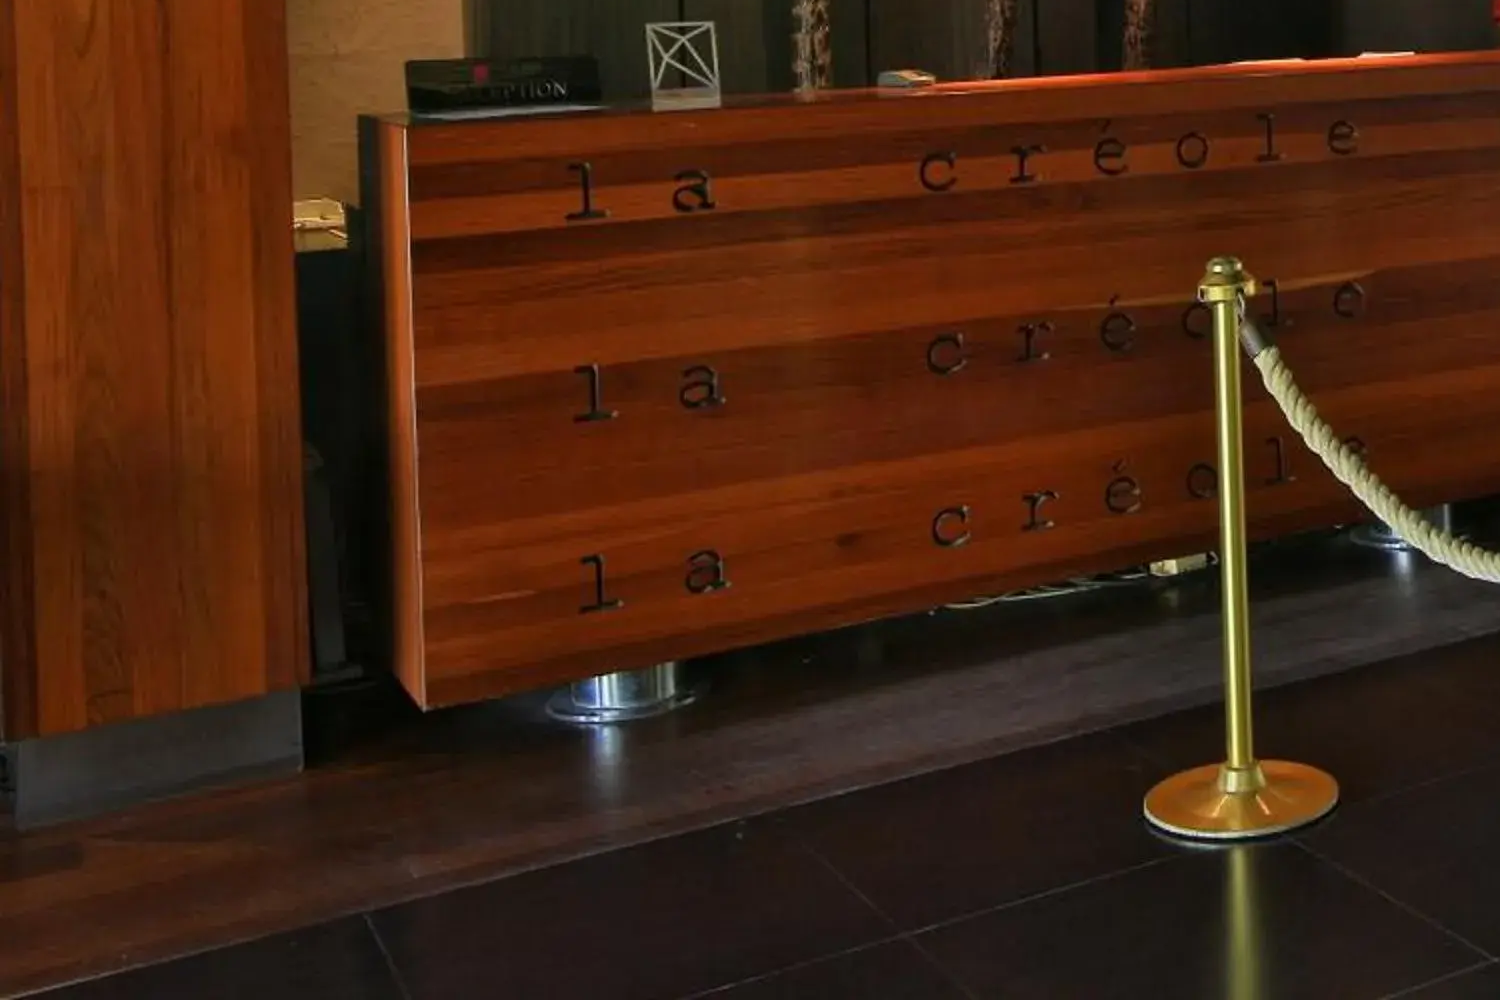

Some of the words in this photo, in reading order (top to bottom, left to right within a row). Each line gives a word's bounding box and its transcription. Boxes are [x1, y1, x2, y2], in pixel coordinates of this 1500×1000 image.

[564, 161, 716, 221] la
[918, 111, 1361, 192] créole
[573, 363, 727, 423] la
[579, 553, 731, 614] la
